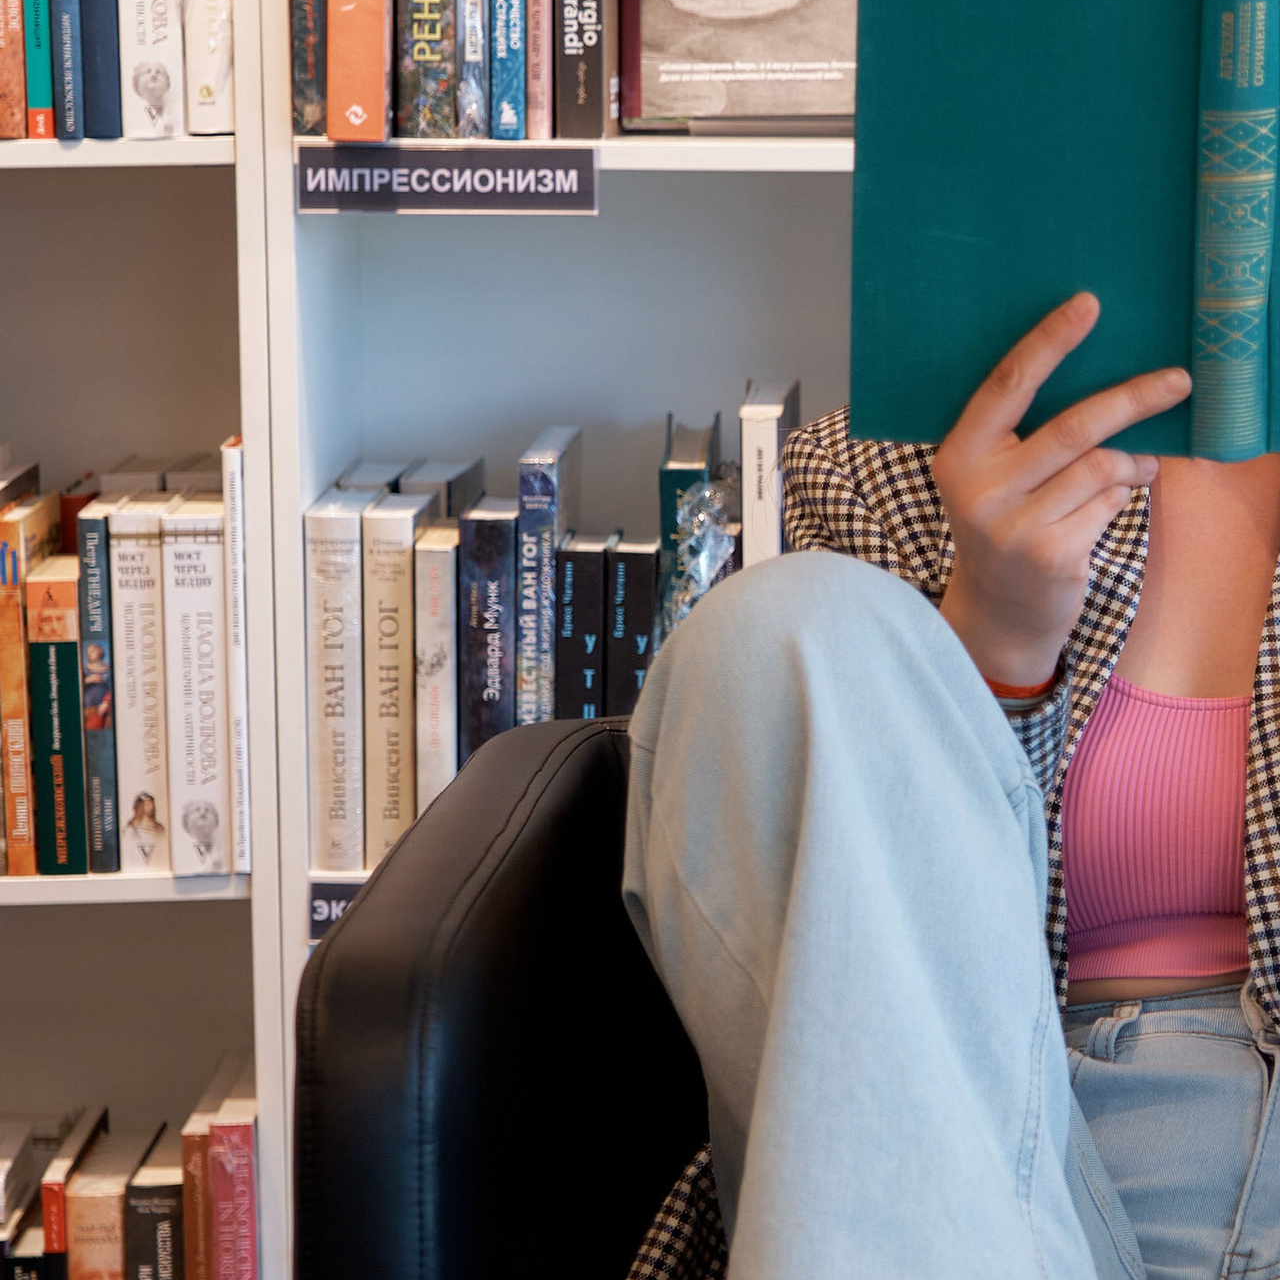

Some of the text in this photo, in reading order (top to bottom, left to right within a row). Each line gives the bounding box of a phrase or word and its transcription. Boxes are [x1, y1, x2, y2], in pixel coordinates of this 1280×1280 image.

[1253, 0, 1267, 87] СОЧИНЕНИЯ
[306, 168, 579, 193] ИМПРЕССИОНИЗМ
[118, 552, 145, 562] МОСТ
[174, 552, 202, 562] МОСТ
[522, 532, 538, 617] ВАН ГОГ
[615, 562, 626, 604] Чатвин
[483, 580, 505, 701] Эдвард Мунк
[140, 603, 160, 776] ПАОЛА ВОЛКОВА
[197, 611, 217, 786] ПАОЛА ВОЛКОВА
[324, 600, 346, 821] Винсент ВАН ГОГ
[378, 600, 400, 821] Винсент ВАН ГОГ
[13, 796, 29, 841] Леонид
